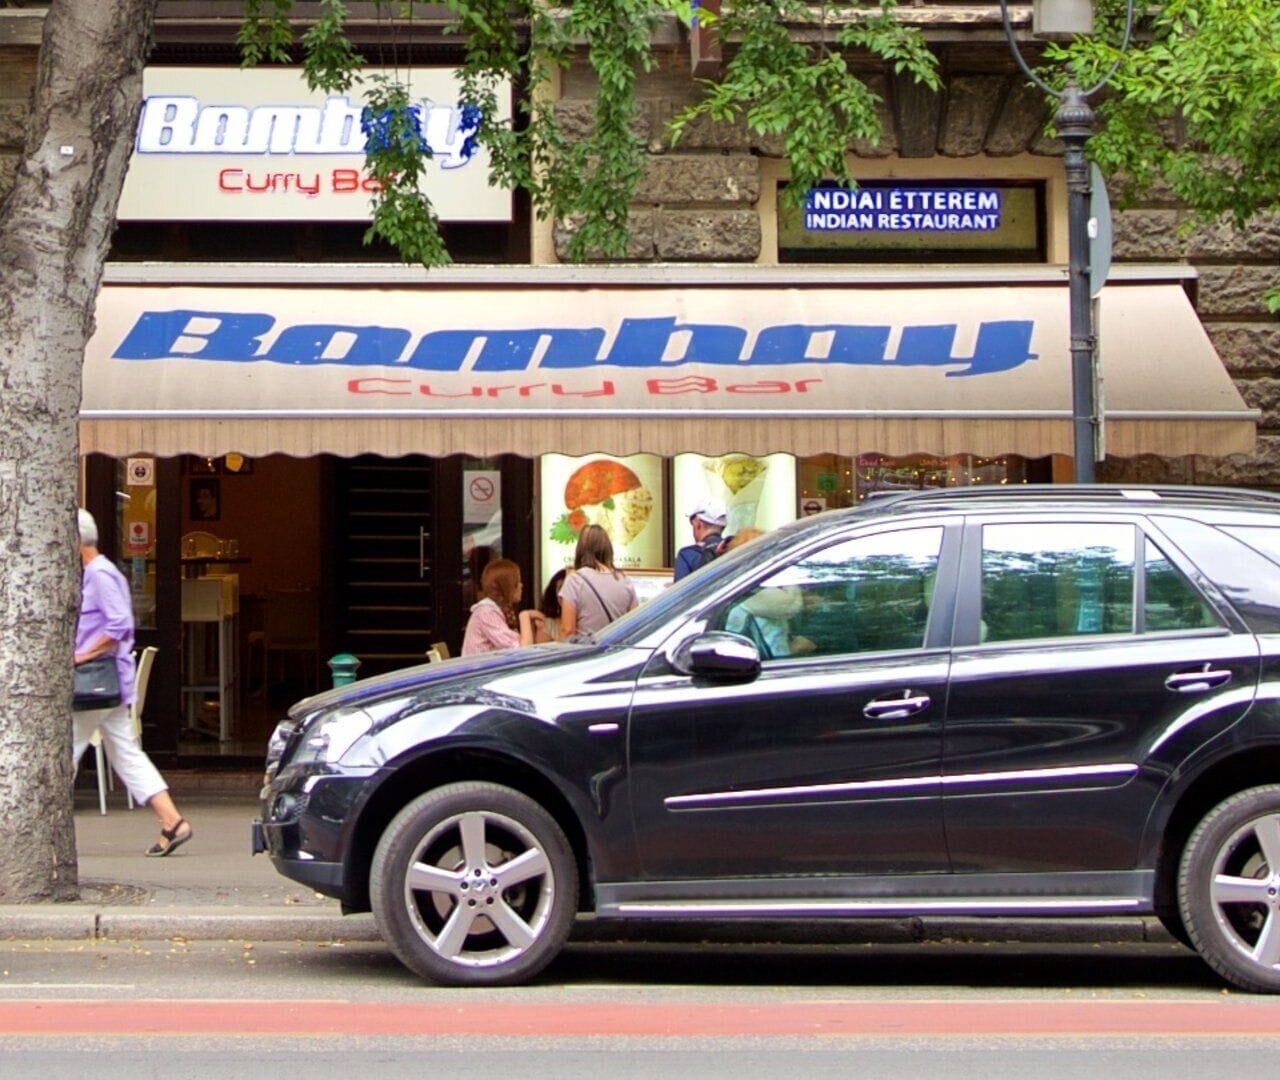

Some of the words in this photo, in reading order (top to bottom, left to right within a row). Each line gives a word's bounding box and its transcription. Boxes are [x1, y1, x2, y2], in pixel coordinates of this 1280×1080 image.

[137, 95, 481, 169] Bomby
[218, 168, 320, 196] Curry
[333, 169, 401, 193] Ba
[889, 188, 999, 210] ÉTTEREM
[807, 213, 873, 229] INDIAN
[877, 213, 999, 229] RESTAURANT
[111, 309, 1039, 377] Bombay
[348, 377, 616, 398] Curry
[645, 375, 823, 395] Bar
